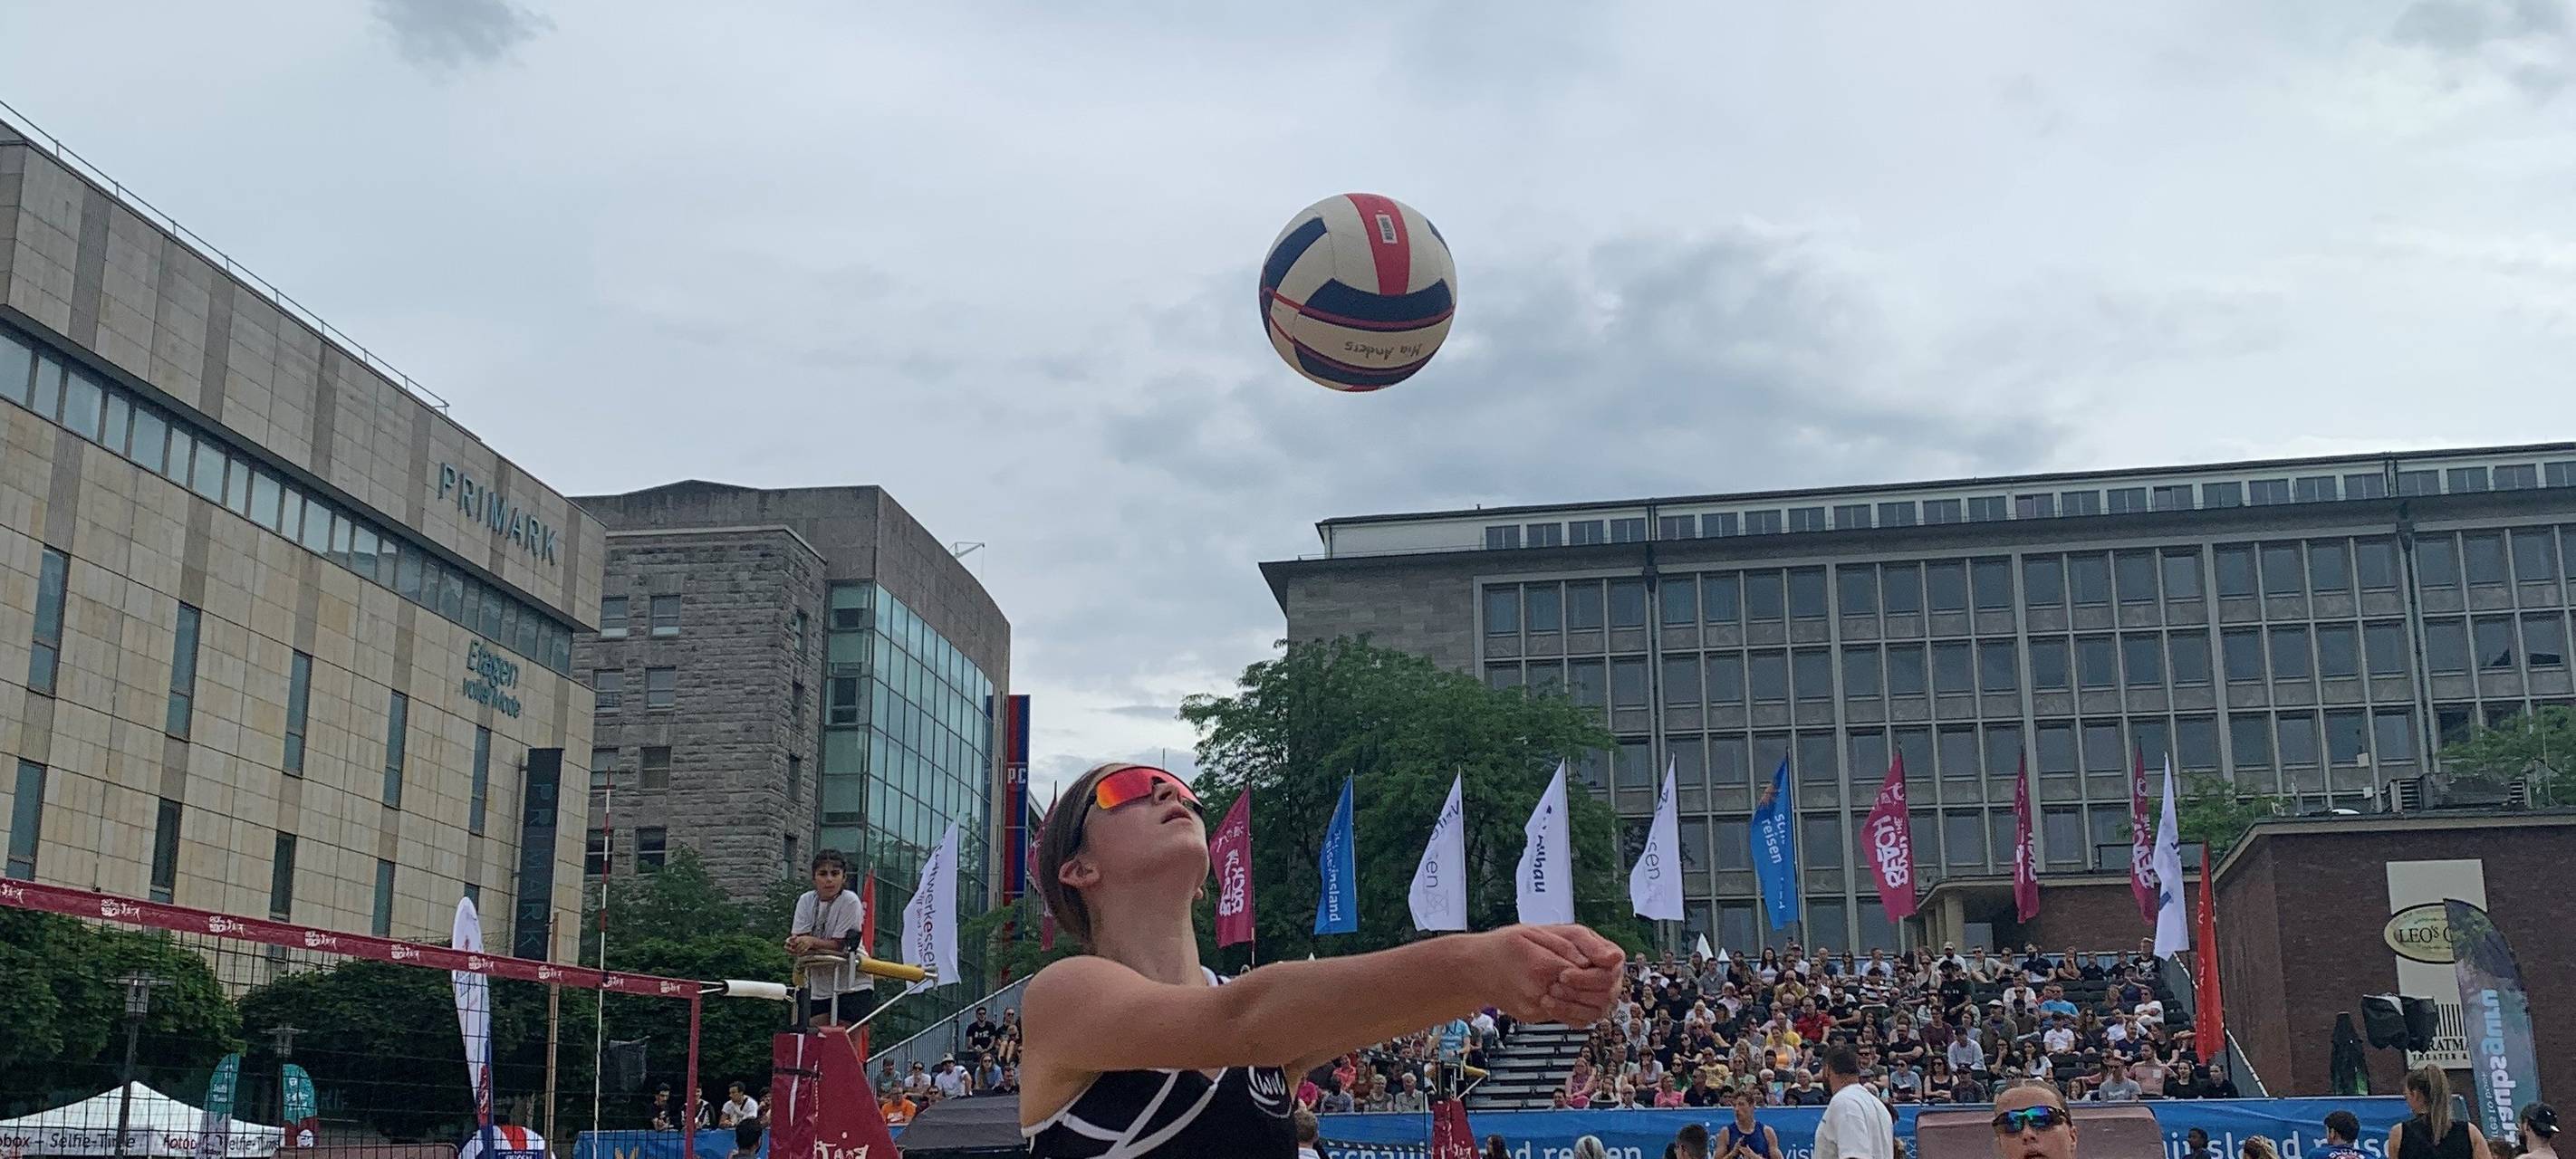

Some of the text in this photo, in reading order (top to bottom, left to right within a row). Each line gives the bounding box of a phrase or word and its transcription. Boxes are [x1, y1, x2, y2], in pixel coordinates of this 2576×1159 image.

[438, 462, 559, 566] PRIMARK
[1762, 818, 1783, 864] reisen
[519, 782, 554, 948] PRIMARK
[1543, 1146, 1642, 1159] reen
[1786, 1143, 1815, 1159] visi
